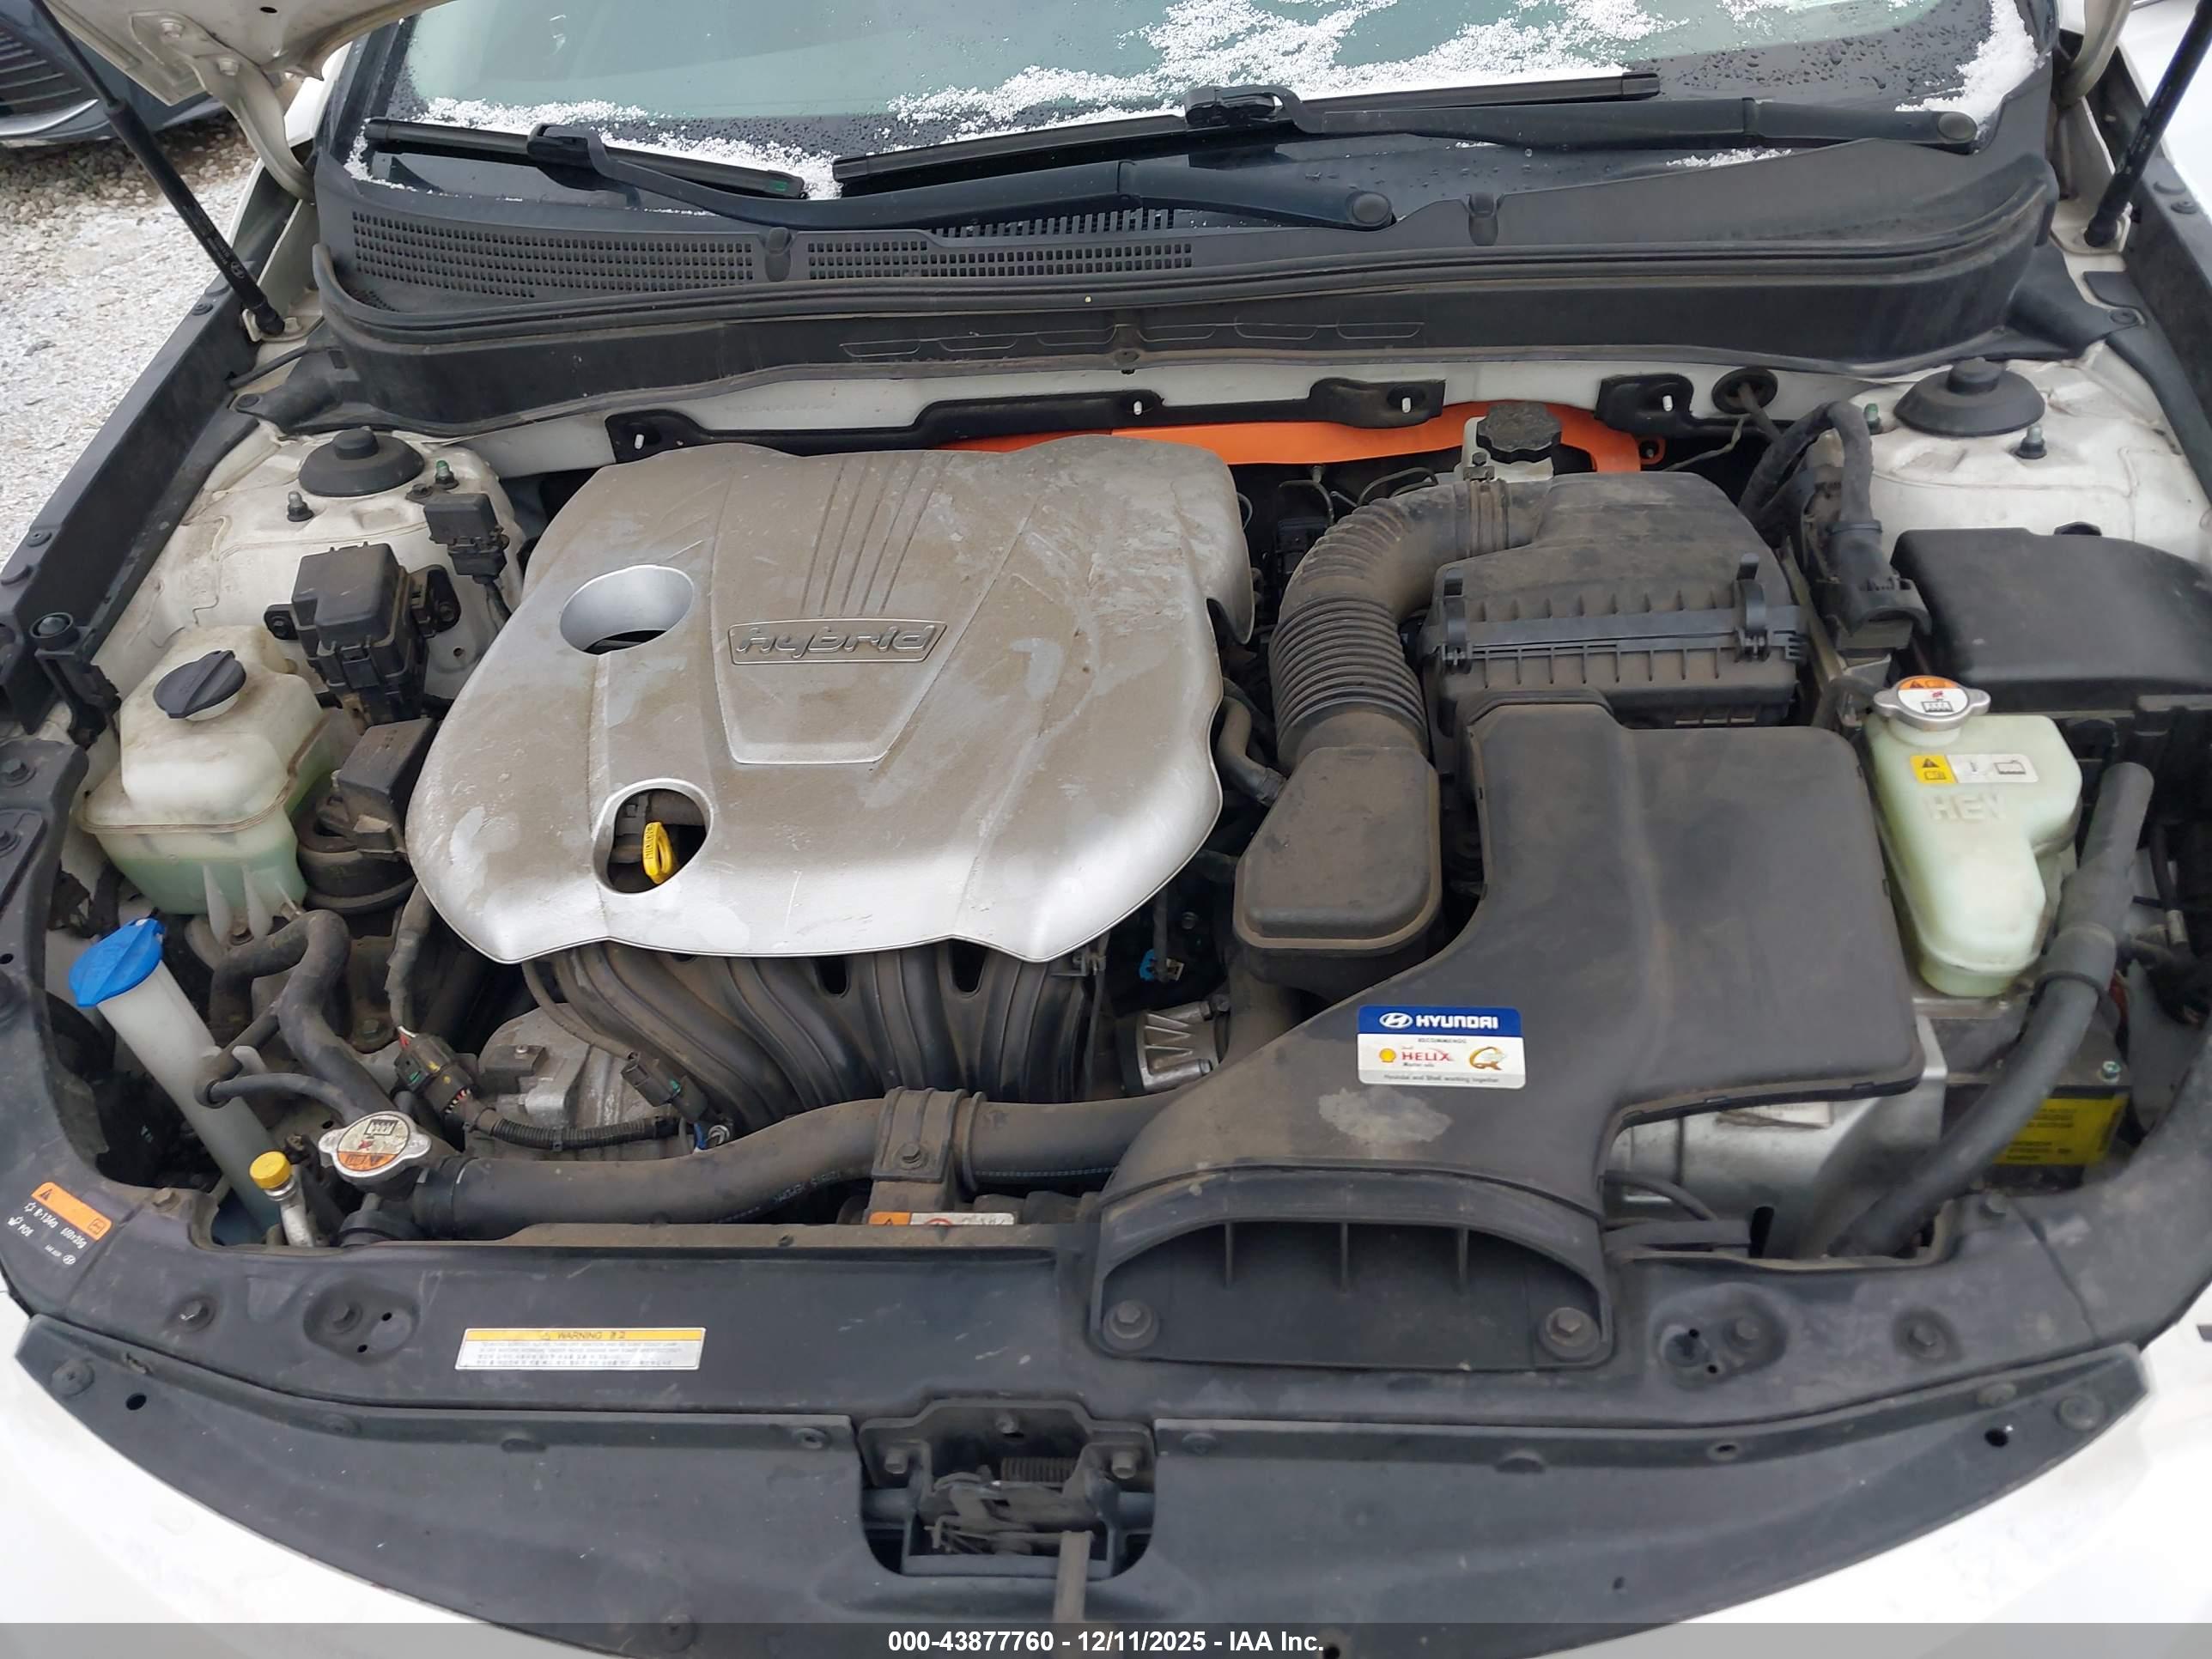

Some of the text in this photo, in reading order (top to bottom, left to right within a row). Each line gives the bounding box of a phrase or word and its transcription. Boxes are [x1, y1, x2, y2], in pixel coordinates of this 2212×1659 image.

[736, 624, 935, 659] hybrid
[1924, 792, 2006, 822] HEV
[1415, 1015, 1498, 1030] HYUNDAI
[1401, 1051, 1453, 1062] HELIX
[557, 1331, 603, 1340] WARNING
